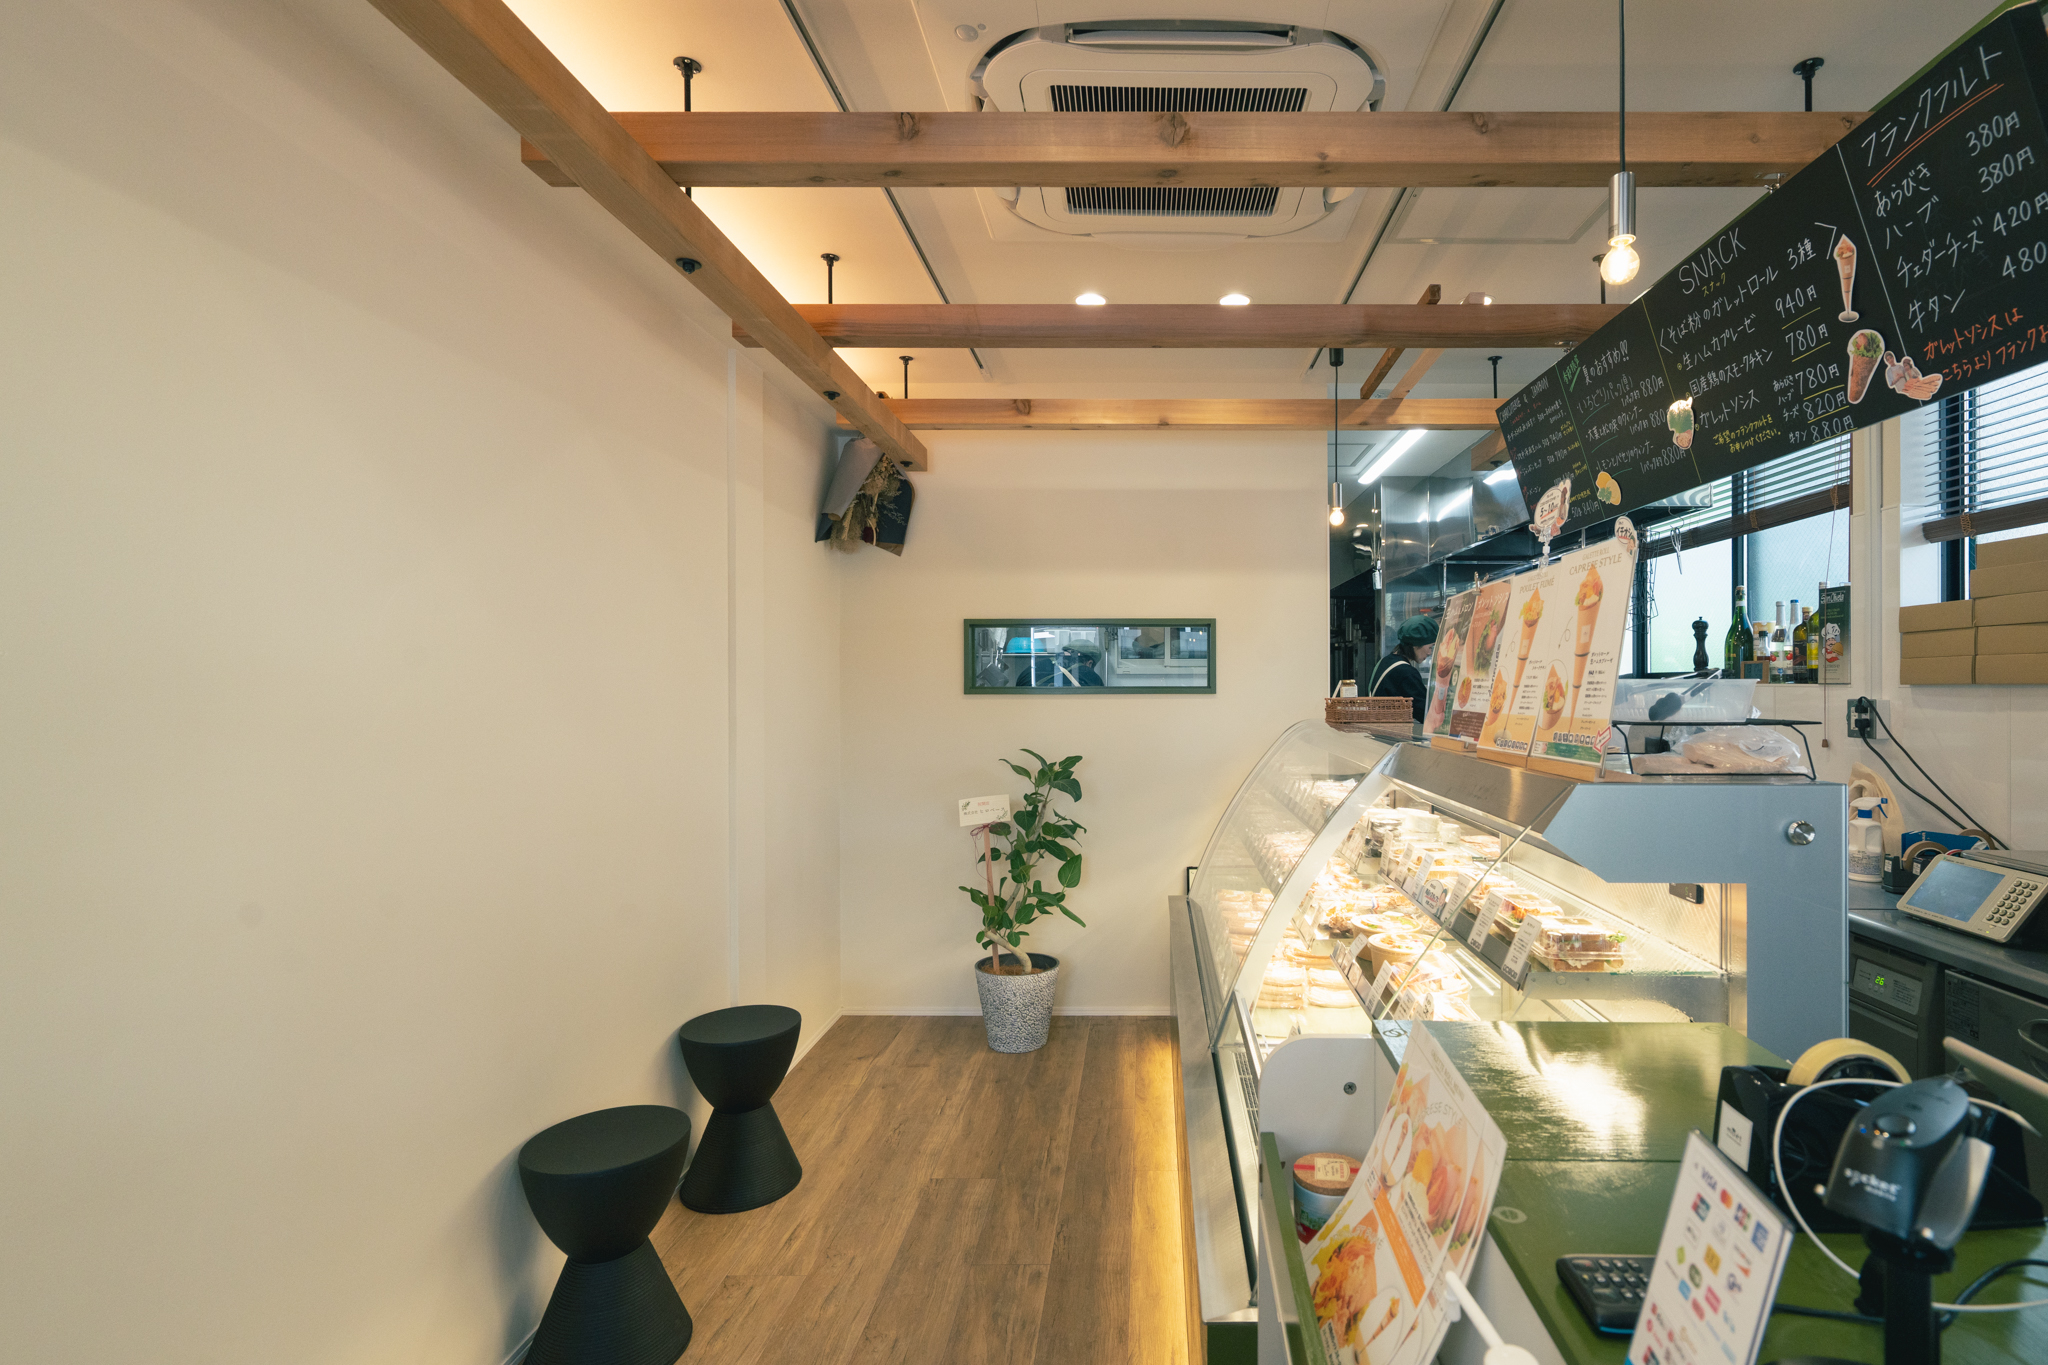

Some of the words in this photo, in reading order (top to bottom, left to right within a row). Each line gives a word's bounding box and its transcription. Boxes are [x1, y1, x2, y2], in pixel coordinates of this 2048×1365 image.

[1861, 46, 2002, 167] フランクフルト
[1874, 162, 1931, 217] あらびき
[1965, 111, 2020, 157] 380円
[1886, 195, 1939, 250] ハーブ
[1978, 146, 2035, 193] 380円
[1678, 227, 1746, 295] SNACK
[1897, 215, 1984, 289] チェダーチーズ
[1701, 271, 1726, 297] スナック
[1775, 285, 1817, 318] 940円
[1908, 288, 1966, 334] 牛タン
[1689, 348, 1773, 399] 国産鶏のスモークチキン
[1785, 323, 1829, 356] 780円
[1772, 374, 1795, 392] あらびき
[1795, 363, 1840, 395] 780円
[1699, 389, 1760, 429] ガレットソシス
[1782, 404, 1799, 422] チーズ
[1802, 391, 1847, 421] 820円
[1811, 415, 1854, 442] 880円
[1598, 552, 1623, 568] STYLE
[1874, 975, 1885, 986] 26
[1701, 1166, 1717, 1191] VISA
